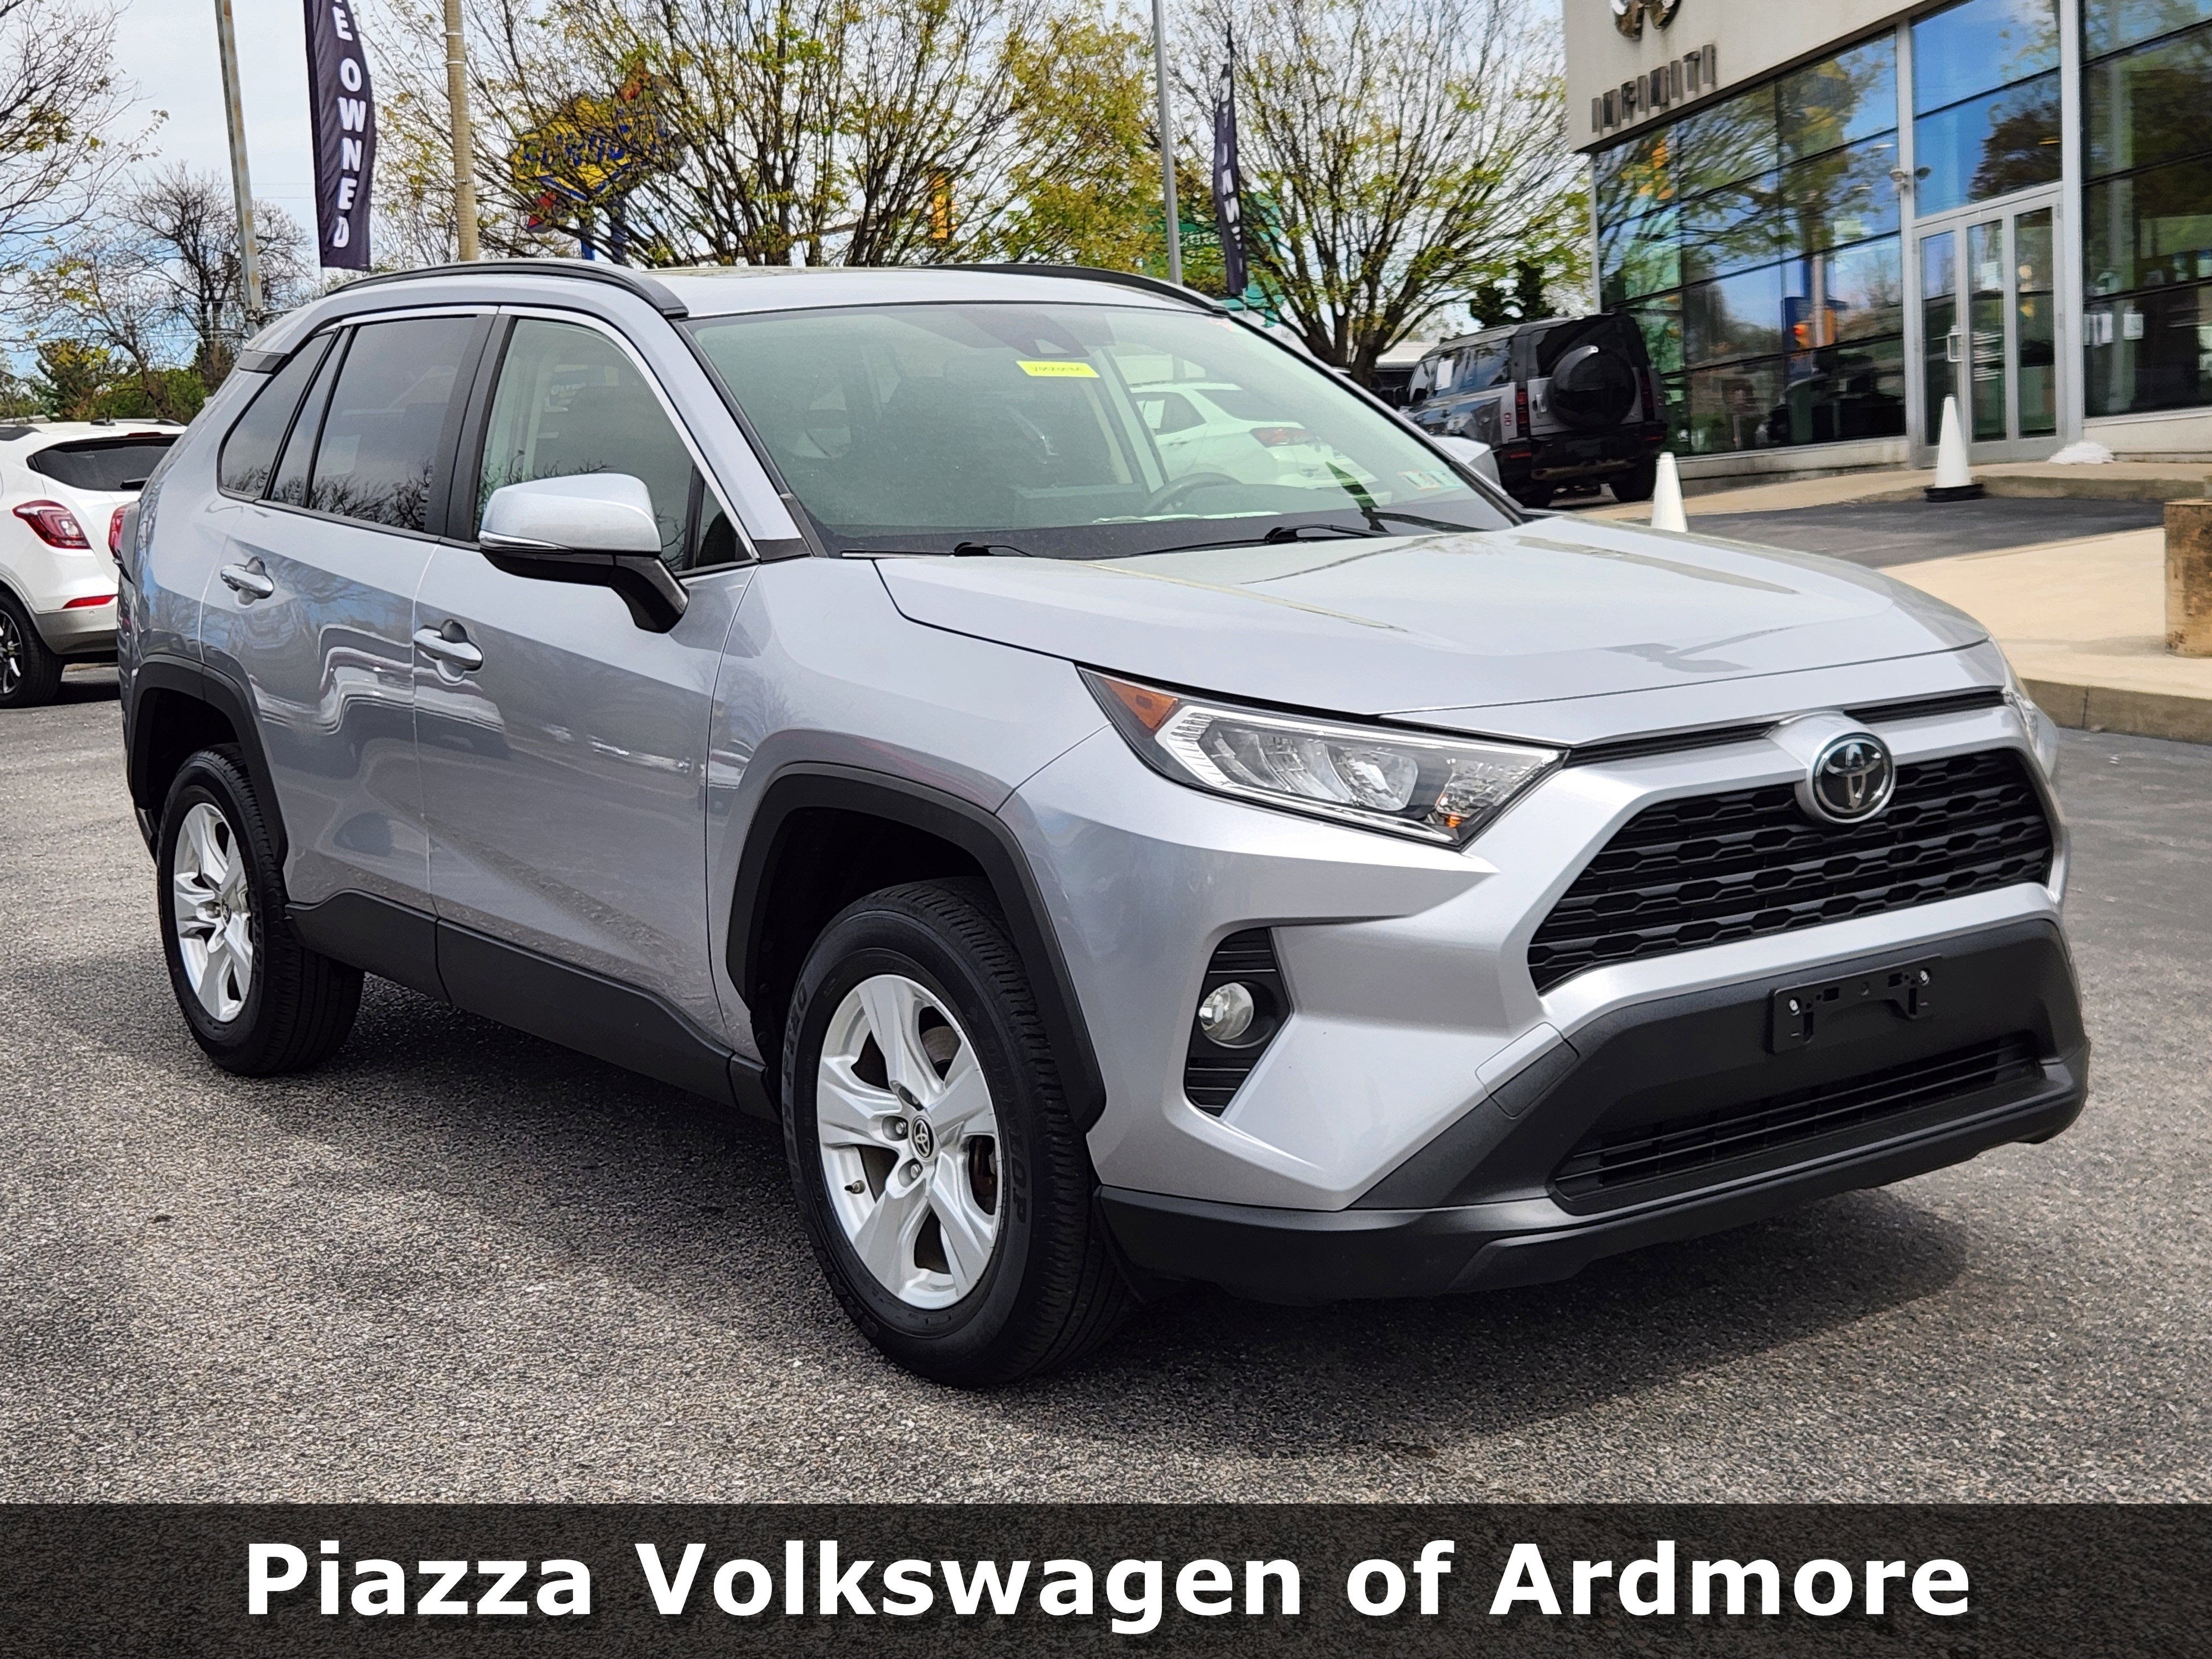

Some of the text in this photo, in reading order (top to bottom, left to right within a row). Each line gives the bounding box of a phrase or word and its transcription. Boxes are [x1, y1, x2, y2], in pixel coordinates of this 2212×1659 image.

[332, 0, 367, 249] E OWNED
[1592, 44, 1716, 133] INFINITI
